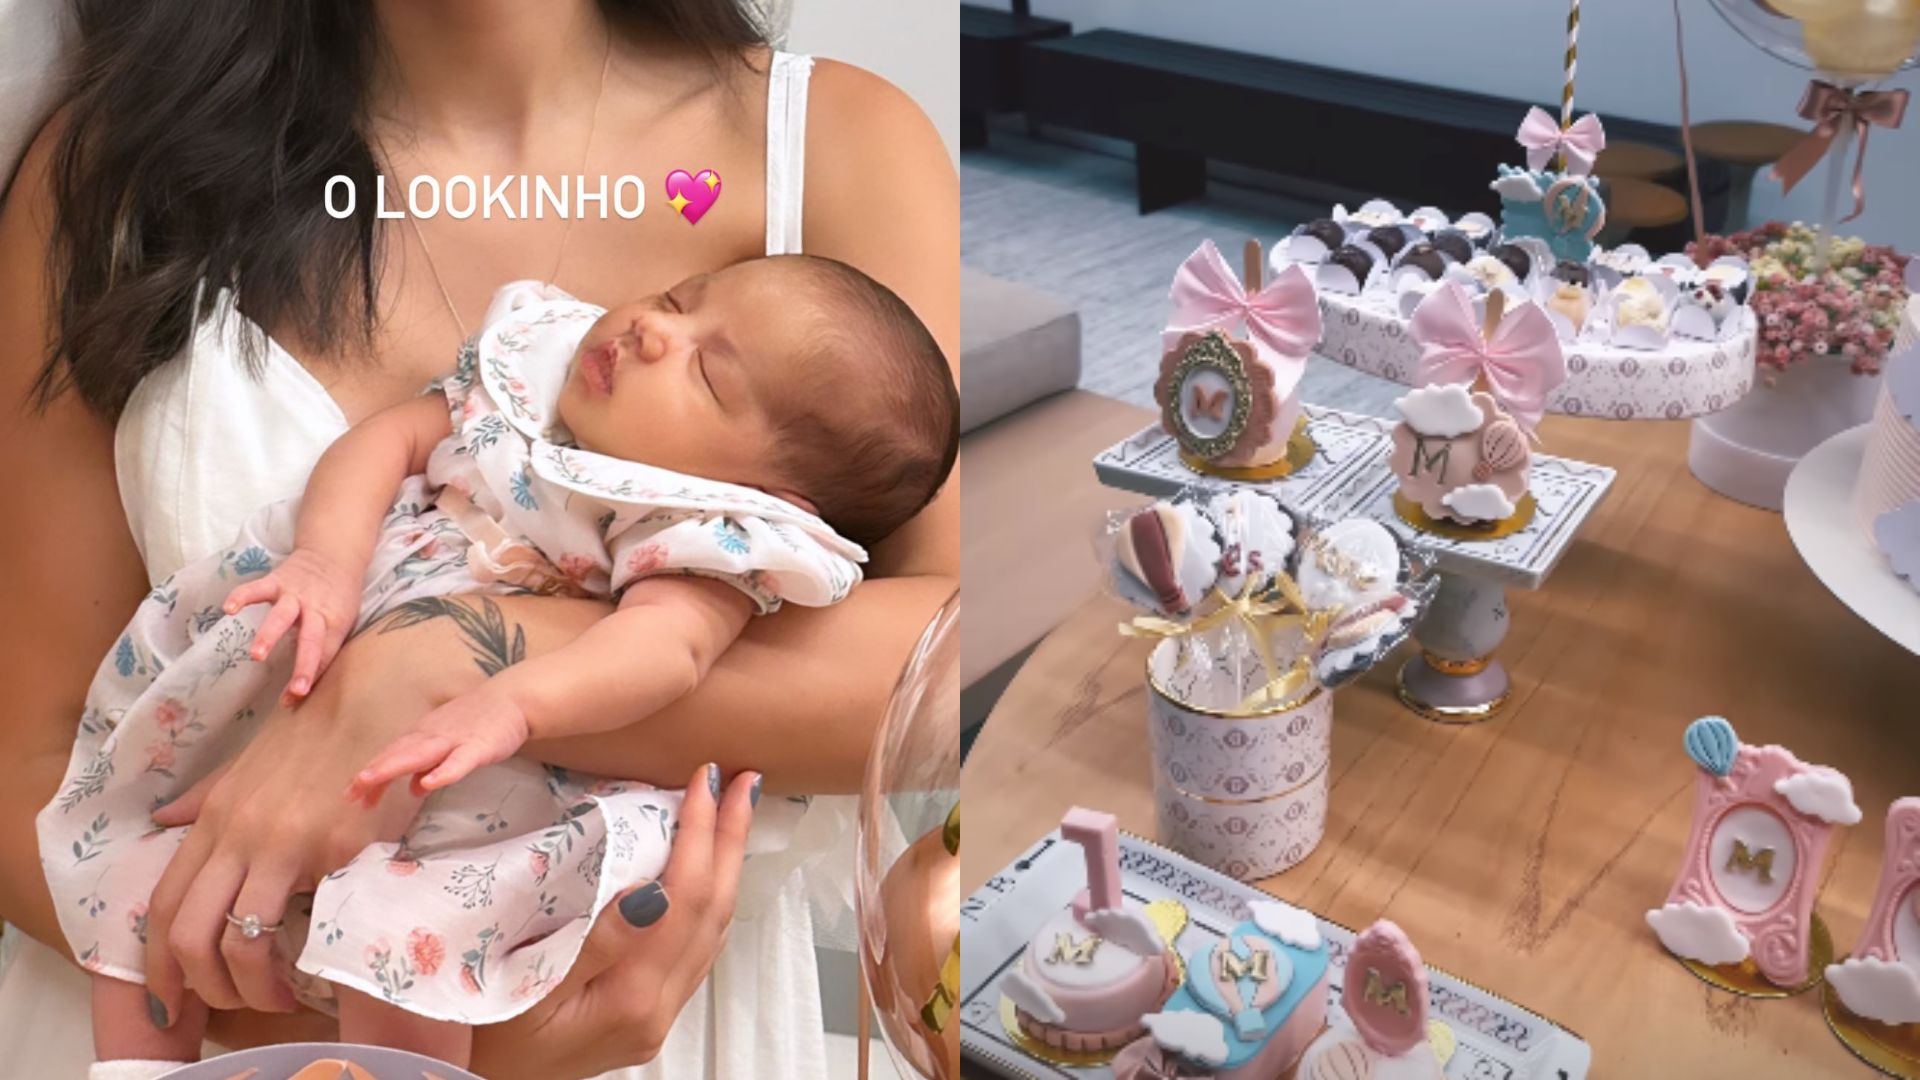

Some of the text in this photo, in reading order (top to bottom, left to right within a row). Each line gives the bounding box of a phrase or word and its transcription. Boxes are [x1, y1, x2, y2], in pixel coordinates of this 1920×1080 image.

[1408, 434, 1450, 485] M
[1724, 837, 1776, 886] M
[1044, 932, 1103, 967] M
[1219, 949, 1269, 983] M
[1363, 967, 1410, 1016] M
